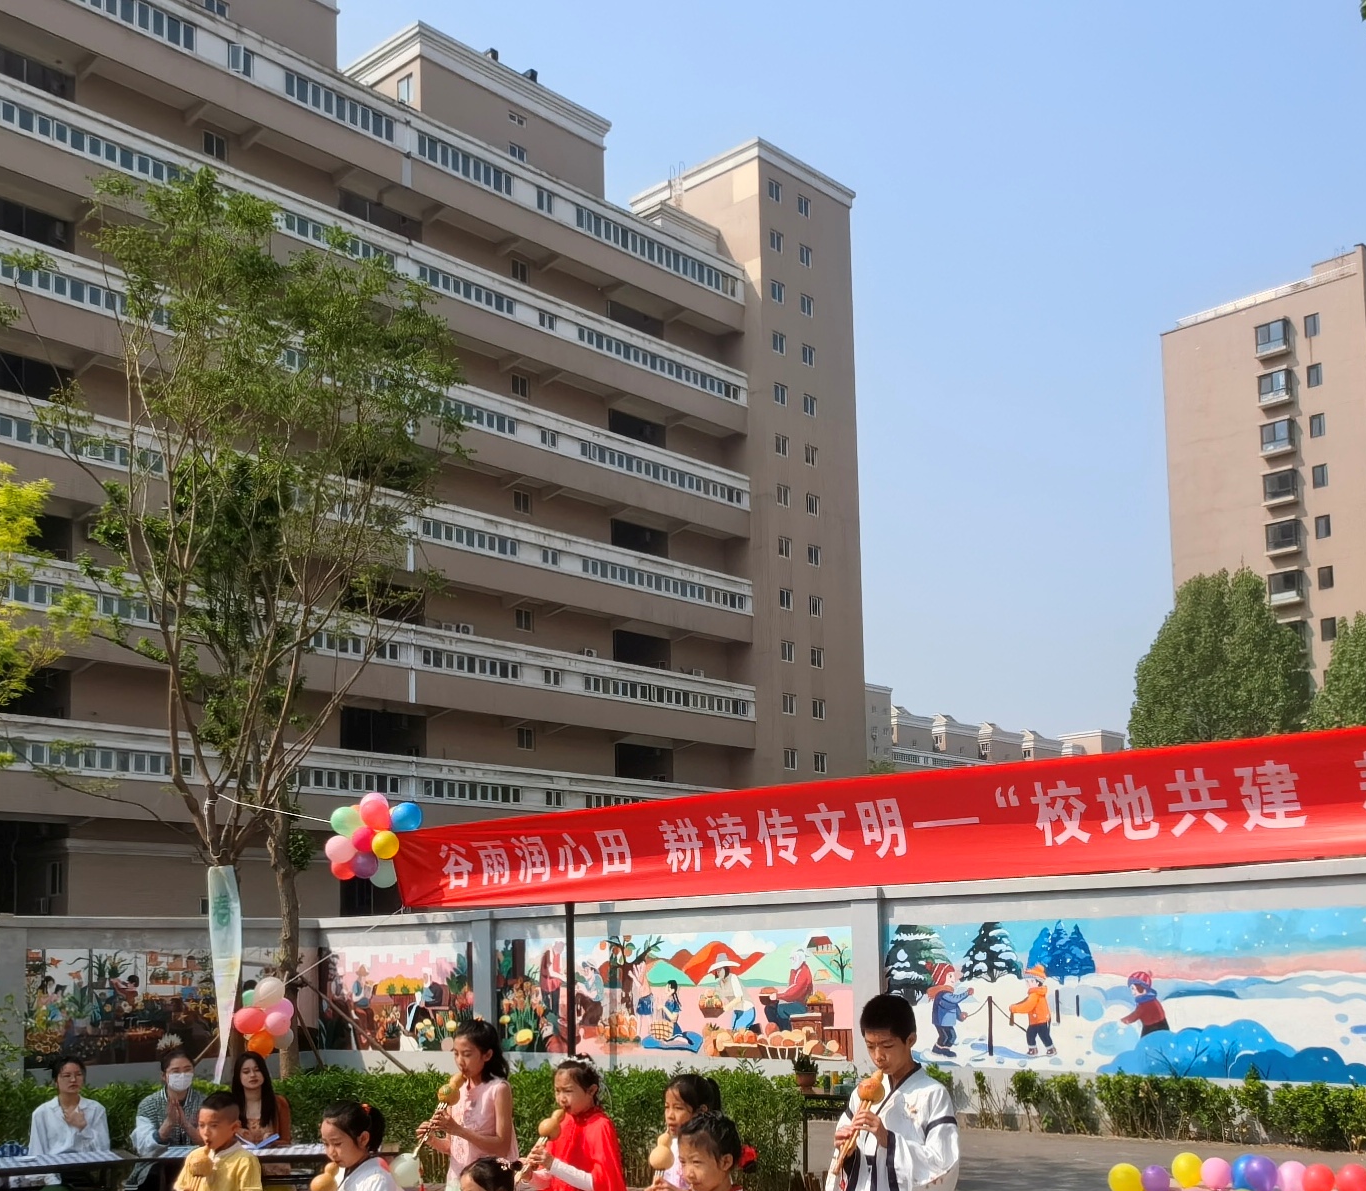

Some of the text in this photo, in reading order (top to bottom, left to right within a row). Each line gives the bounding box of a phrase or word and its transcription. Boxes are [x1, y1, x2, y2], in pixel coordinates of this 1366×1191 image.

[439, 828, 633, 890] 谷雨润心田
